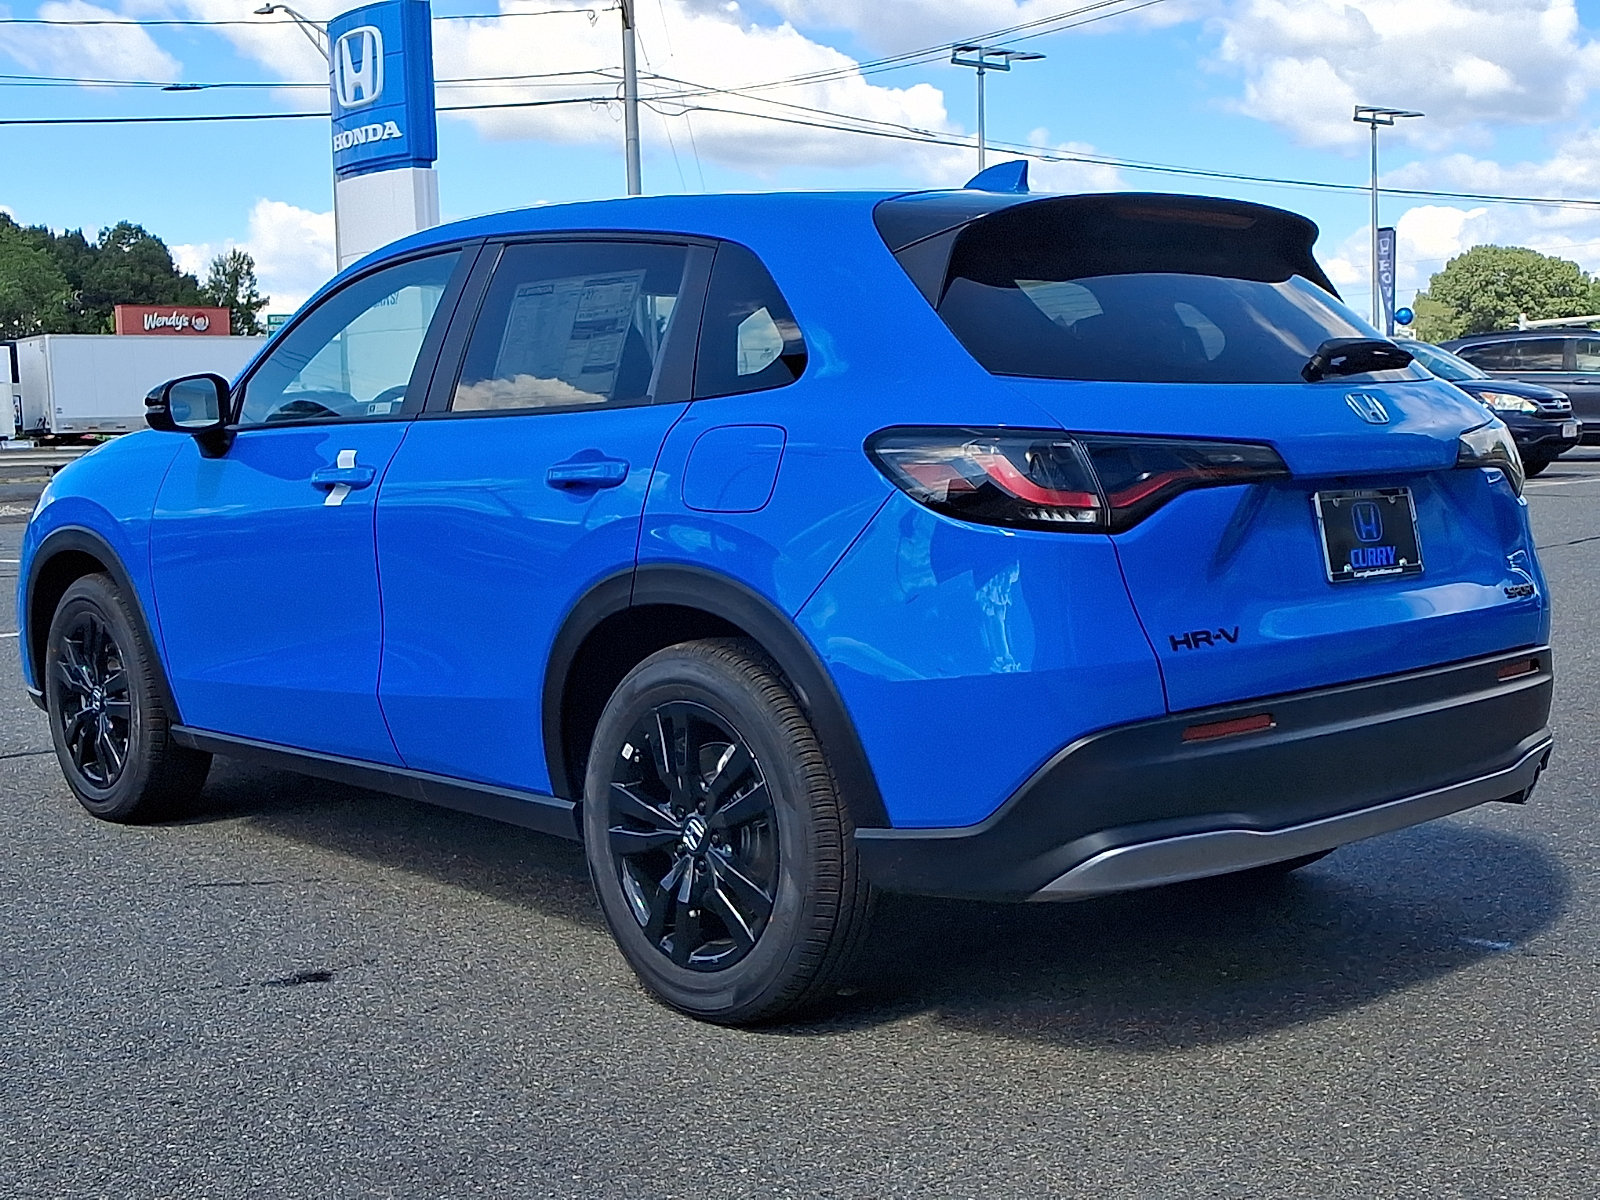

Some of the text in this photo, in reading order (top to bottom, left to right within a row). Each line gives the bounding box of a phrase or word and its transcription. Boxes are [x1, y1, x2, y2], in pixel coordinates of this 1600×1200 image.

[333, 121, 403, 152] HONDA
[143, 311, 189, 331] Wendy's
[1350, 546, 1396, 569] CURRY
[1169, 626, 1239, 651] HR-V
